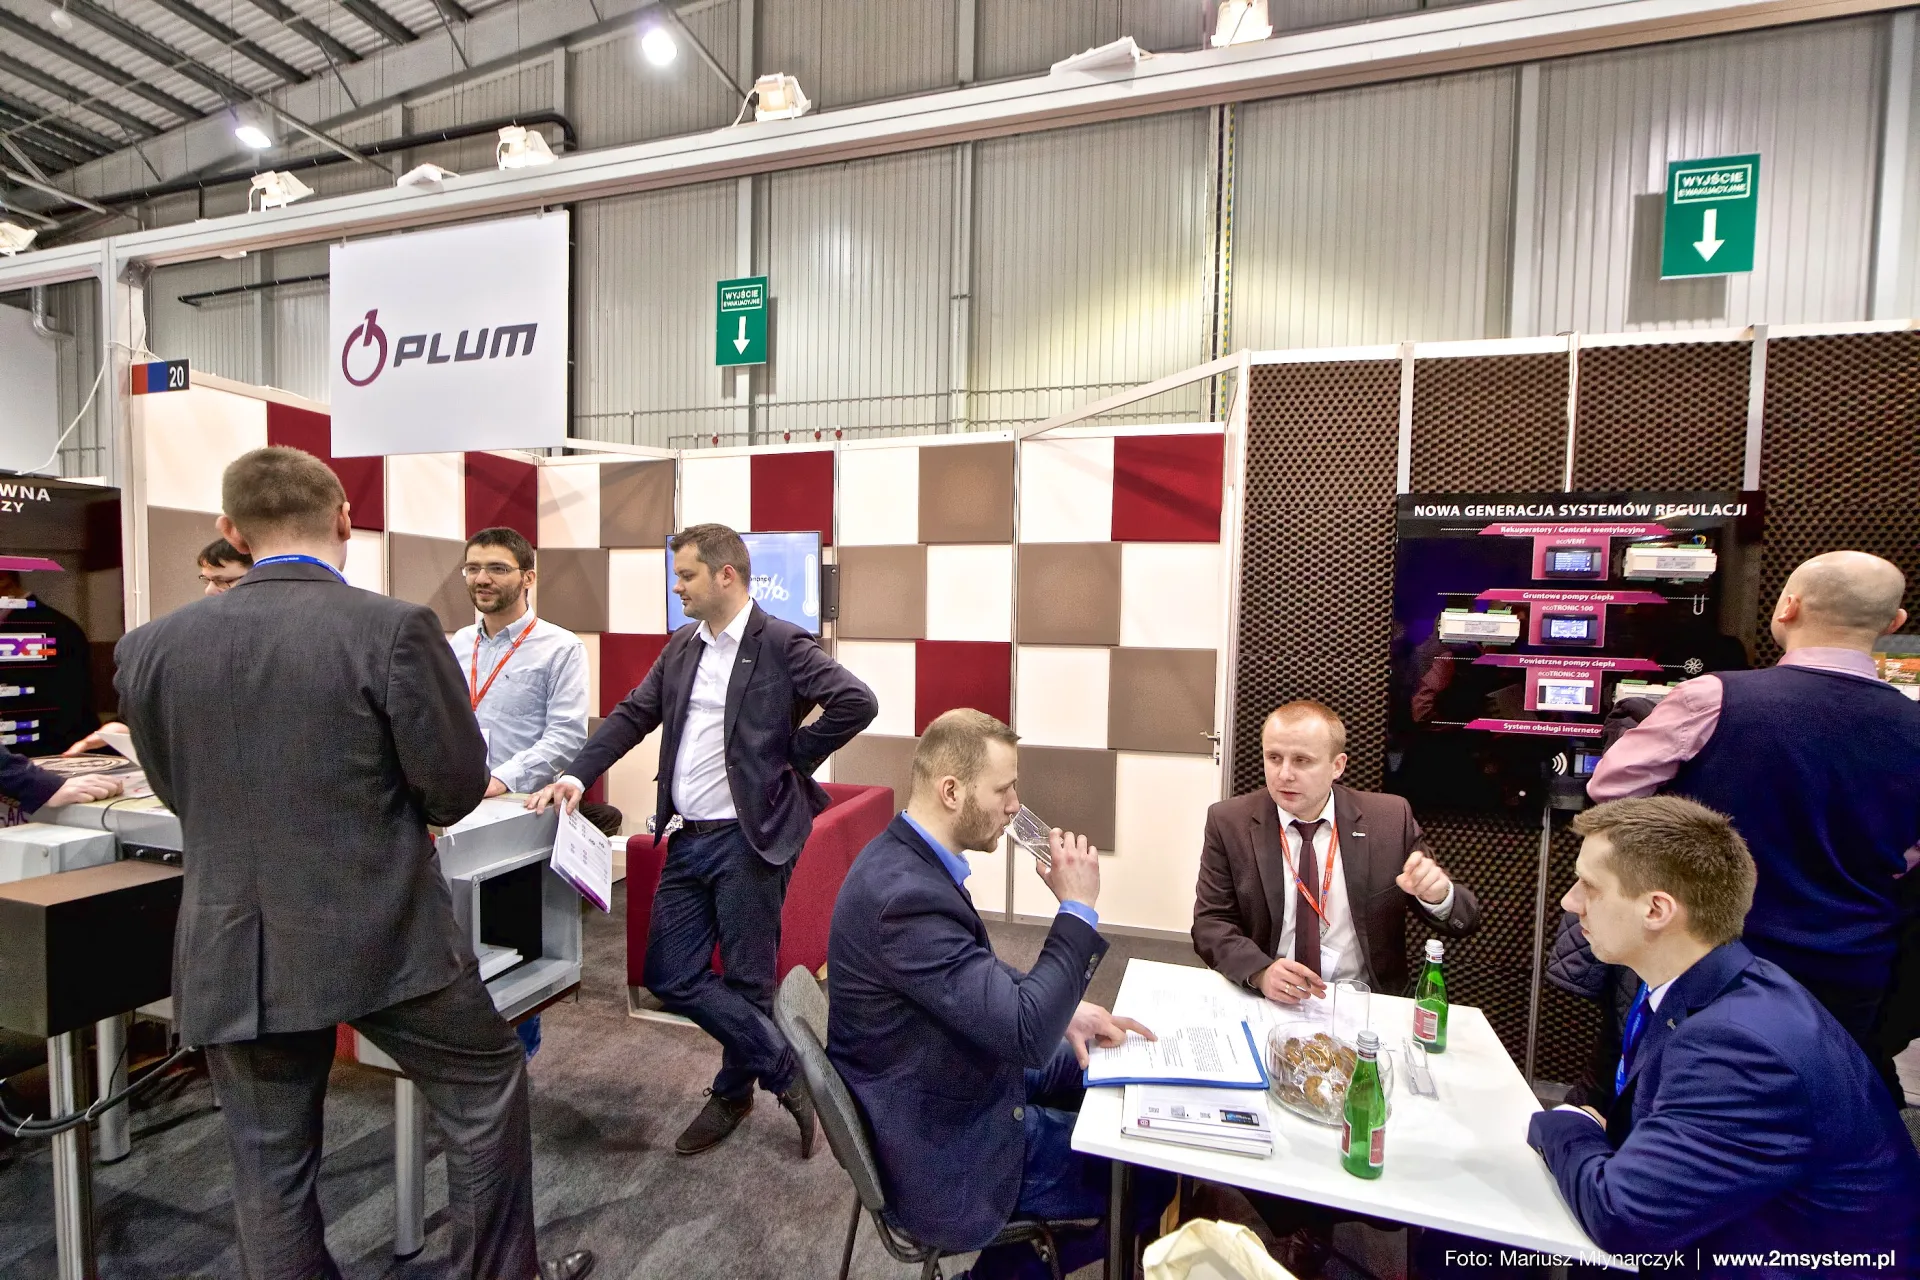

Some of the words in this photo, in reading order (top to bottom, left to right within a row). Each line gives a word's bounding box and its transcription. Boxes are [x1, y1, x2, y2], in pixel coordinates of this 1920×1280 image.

[1682, 172, 1744, 187] WYJŚCIE
[1678, 183, 1747, 198] EWAKUACYJNE
[725, 289, 759, 300] WYJŚCIE
[393, 323, 538, 368] PLUM
[169, 365, 184, 388] 20
[1414, 504, 1460, 517] NOWA
[1464, 504, 1555, 517] GENERACJA
[1559, 501, 1650, 517] SYSTEMÓW
[1655, 503, 1747, 516] REGULACJI
[1500, 526, 1552, 534] Rekuperatory
[1593, 526, 1646, 534] wentylacyjne
[1523, 592, 1560, 600] Gruntowe
[1520, 657, 1561, 665] Powietrzne
